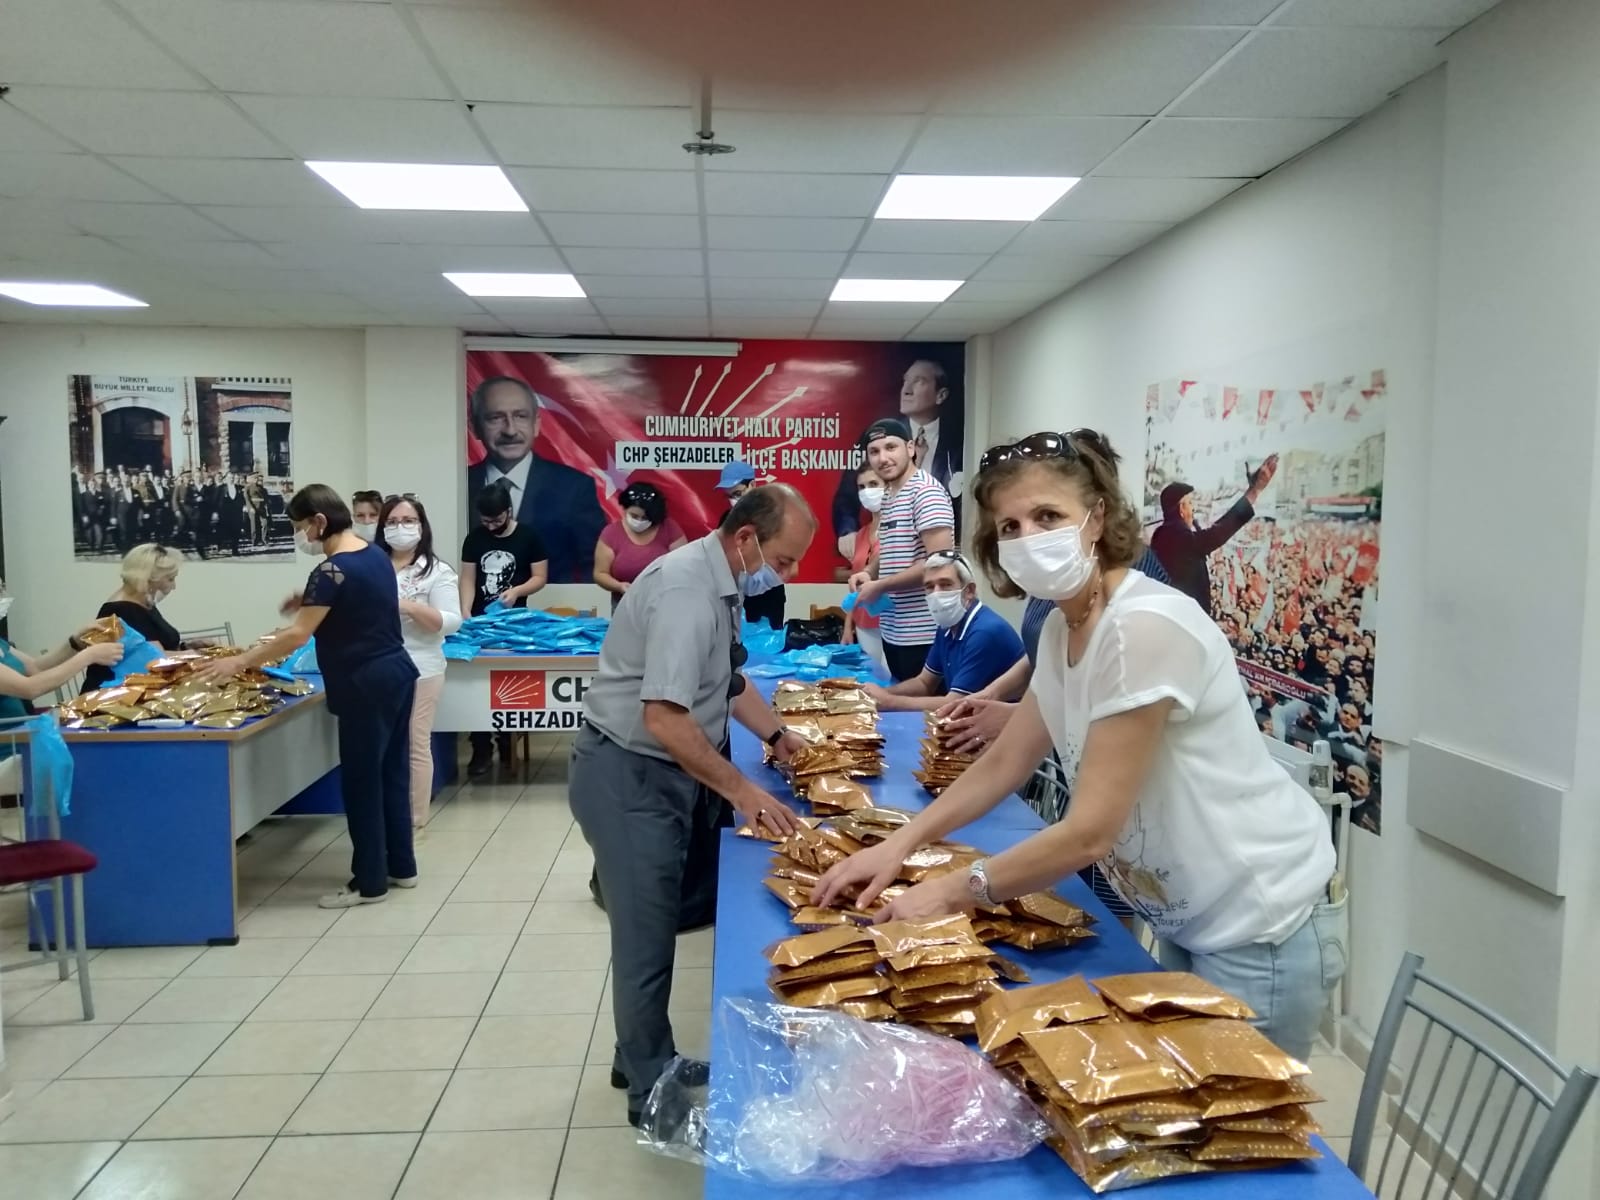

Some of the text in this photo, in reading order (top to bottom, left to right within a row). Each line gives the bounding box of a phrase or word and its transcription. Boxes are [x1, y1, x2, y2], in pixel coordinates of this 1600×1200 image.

[645, 411, 840, 438] CUMHURİYET HALK PARTİSİ
[623, 446, 650, 463] CHP
[654, 446, 734, 468] ŞEHZADELER
[746, 443, 777, 475] İLÇE
